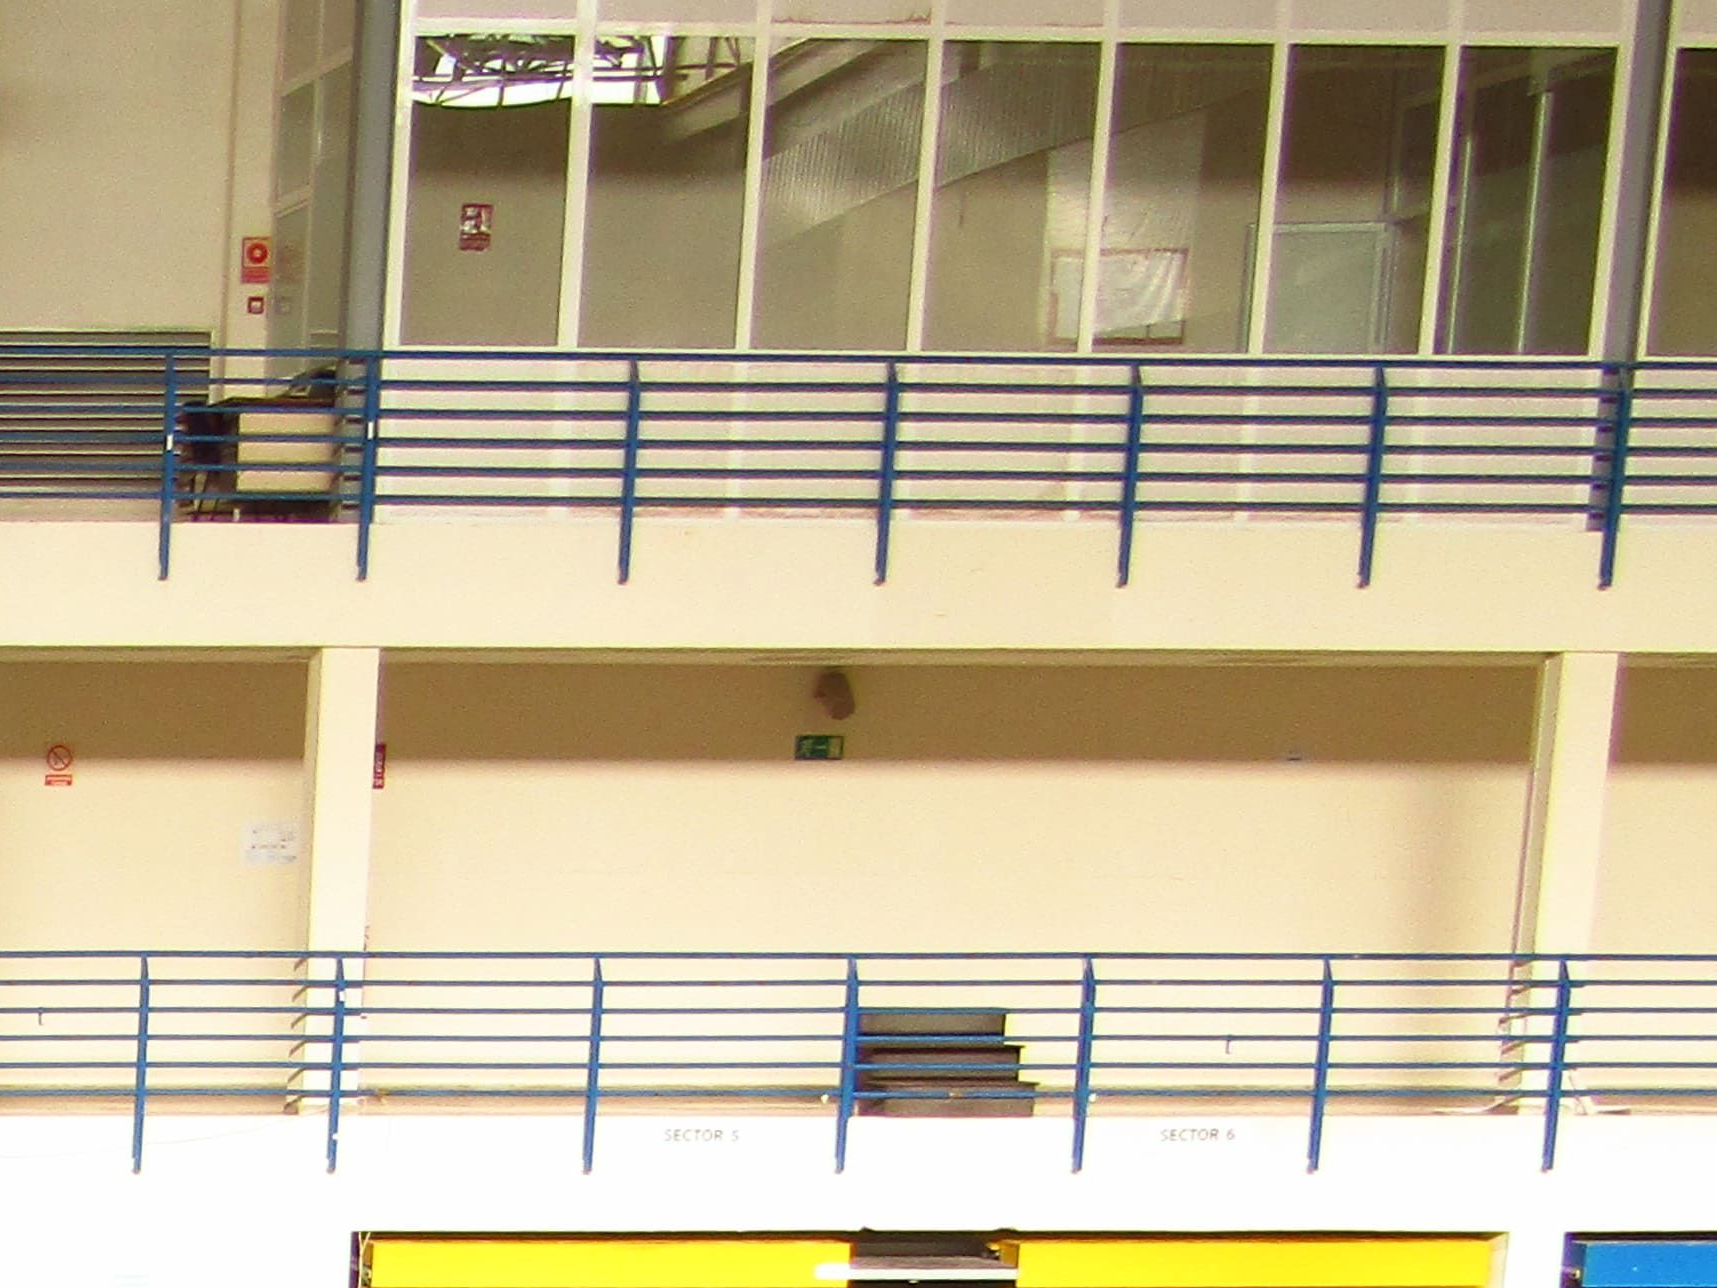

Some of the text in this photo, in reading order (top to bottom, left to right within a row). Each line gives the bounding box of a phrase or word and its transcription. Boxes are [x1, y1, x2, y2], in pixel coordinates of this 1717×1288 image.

[664, 1128, 723, 1142] SECTOR
[1160, 1128, 1236, 1142] SECTOR 6
